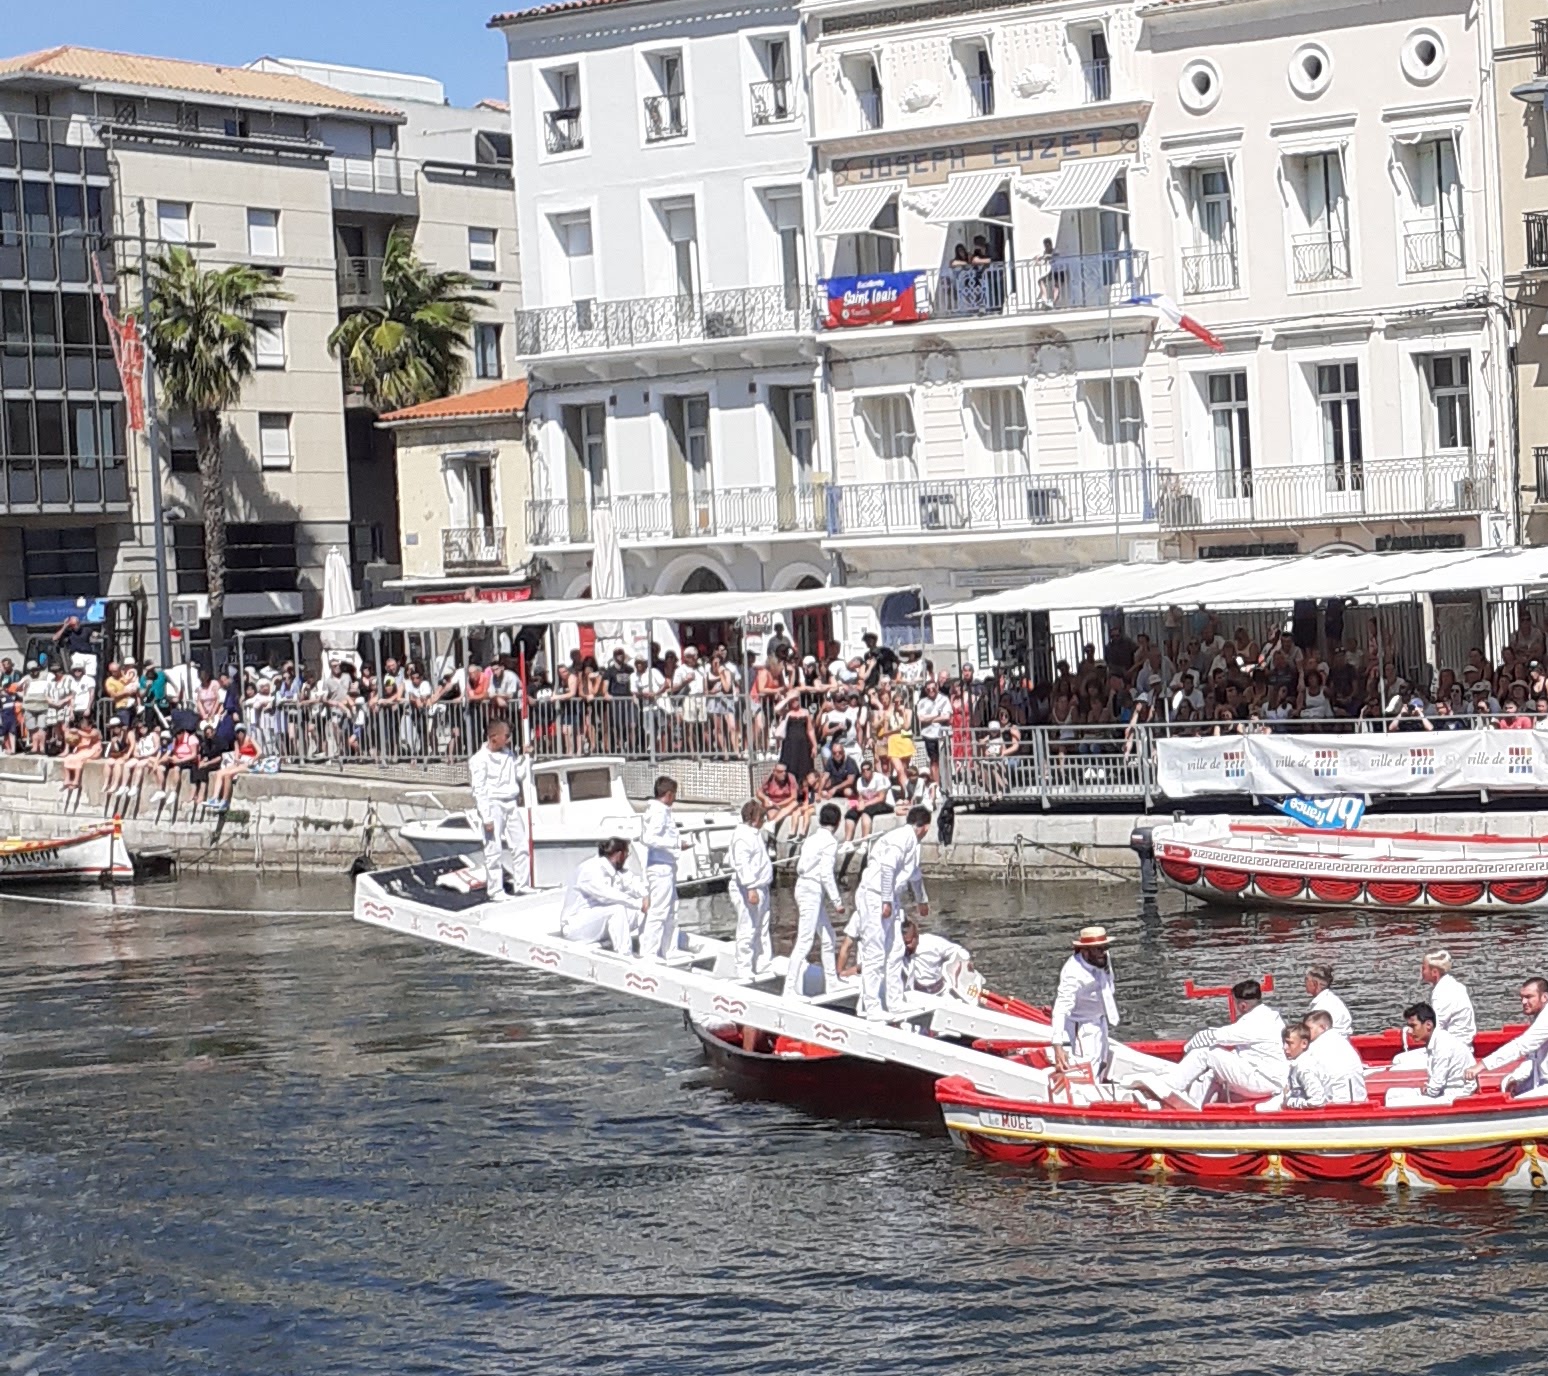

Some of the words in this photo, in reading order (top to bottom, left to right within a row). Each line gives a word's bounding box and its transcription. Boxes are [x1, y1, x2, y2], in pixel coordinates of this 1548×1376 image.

[860, 149, 966, 179] JOSEPH
[992, 132, 1107, 164] EUZET
[1187, 757, 1208, 770] ville
[1210, 757, 1221, 769] de
[1275, 755, 1296, 768] ville
[1296, 755, 1310, 767] de
[1370, 754, 1392, 767] ville
[1395, 754, 1407, 766] de
[1467, 752, 1489, 765] ville
[1492, 752, 1505, 764] de
[1289, 797, 1327, 826] france
